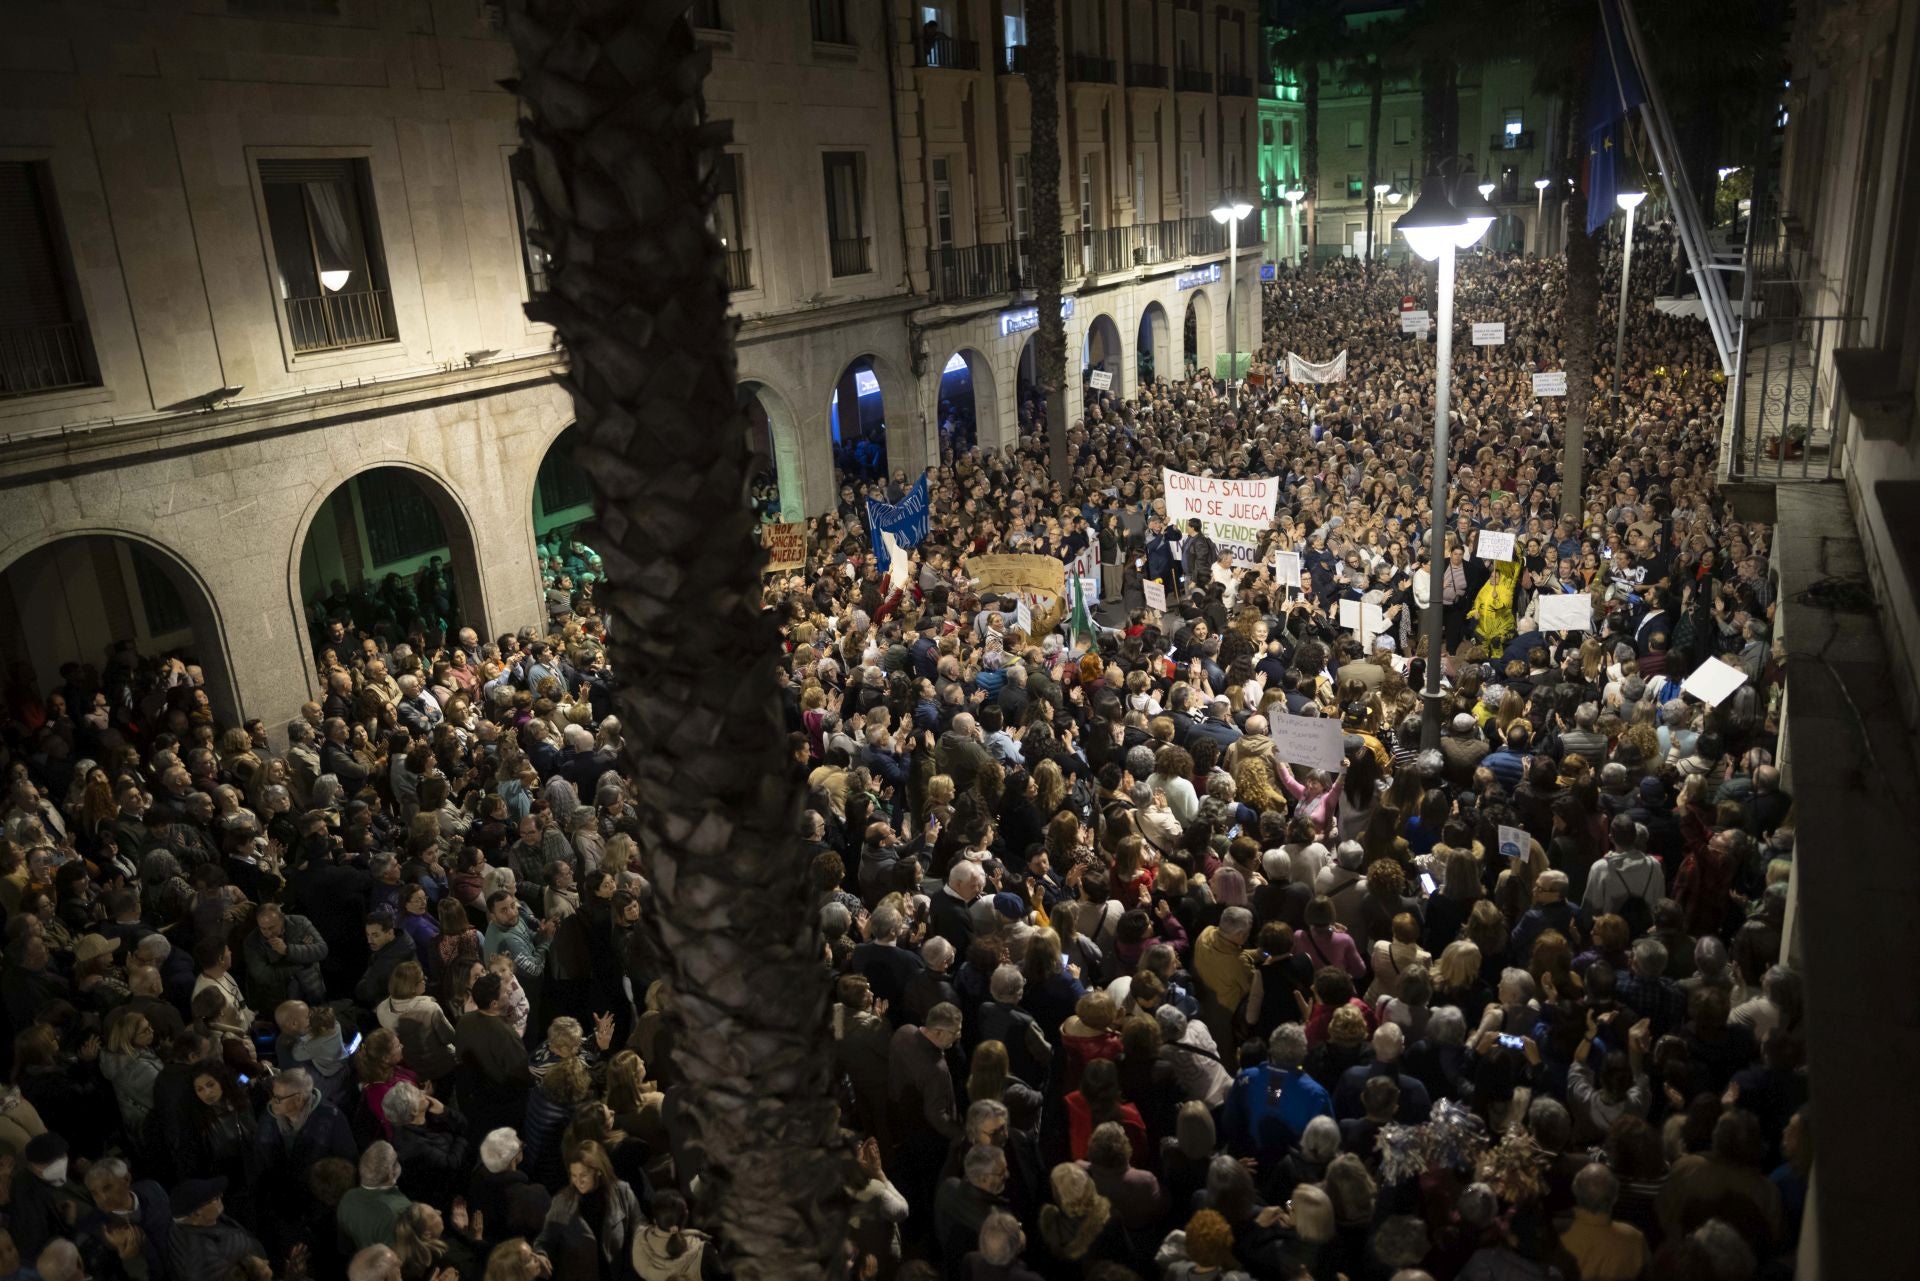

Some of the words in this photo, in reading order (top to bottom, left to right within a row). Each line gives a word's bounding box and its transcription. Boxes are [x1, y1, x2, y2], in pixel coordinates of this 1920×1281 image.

[1170, 474, 1196, 491] CON
[1199, 480, 1217, 494] LA
[1222, 481, 1267, 498] SALUD
[1185, 497, 1202, 513] NO
[1207, 500, 1223, 516] SE
